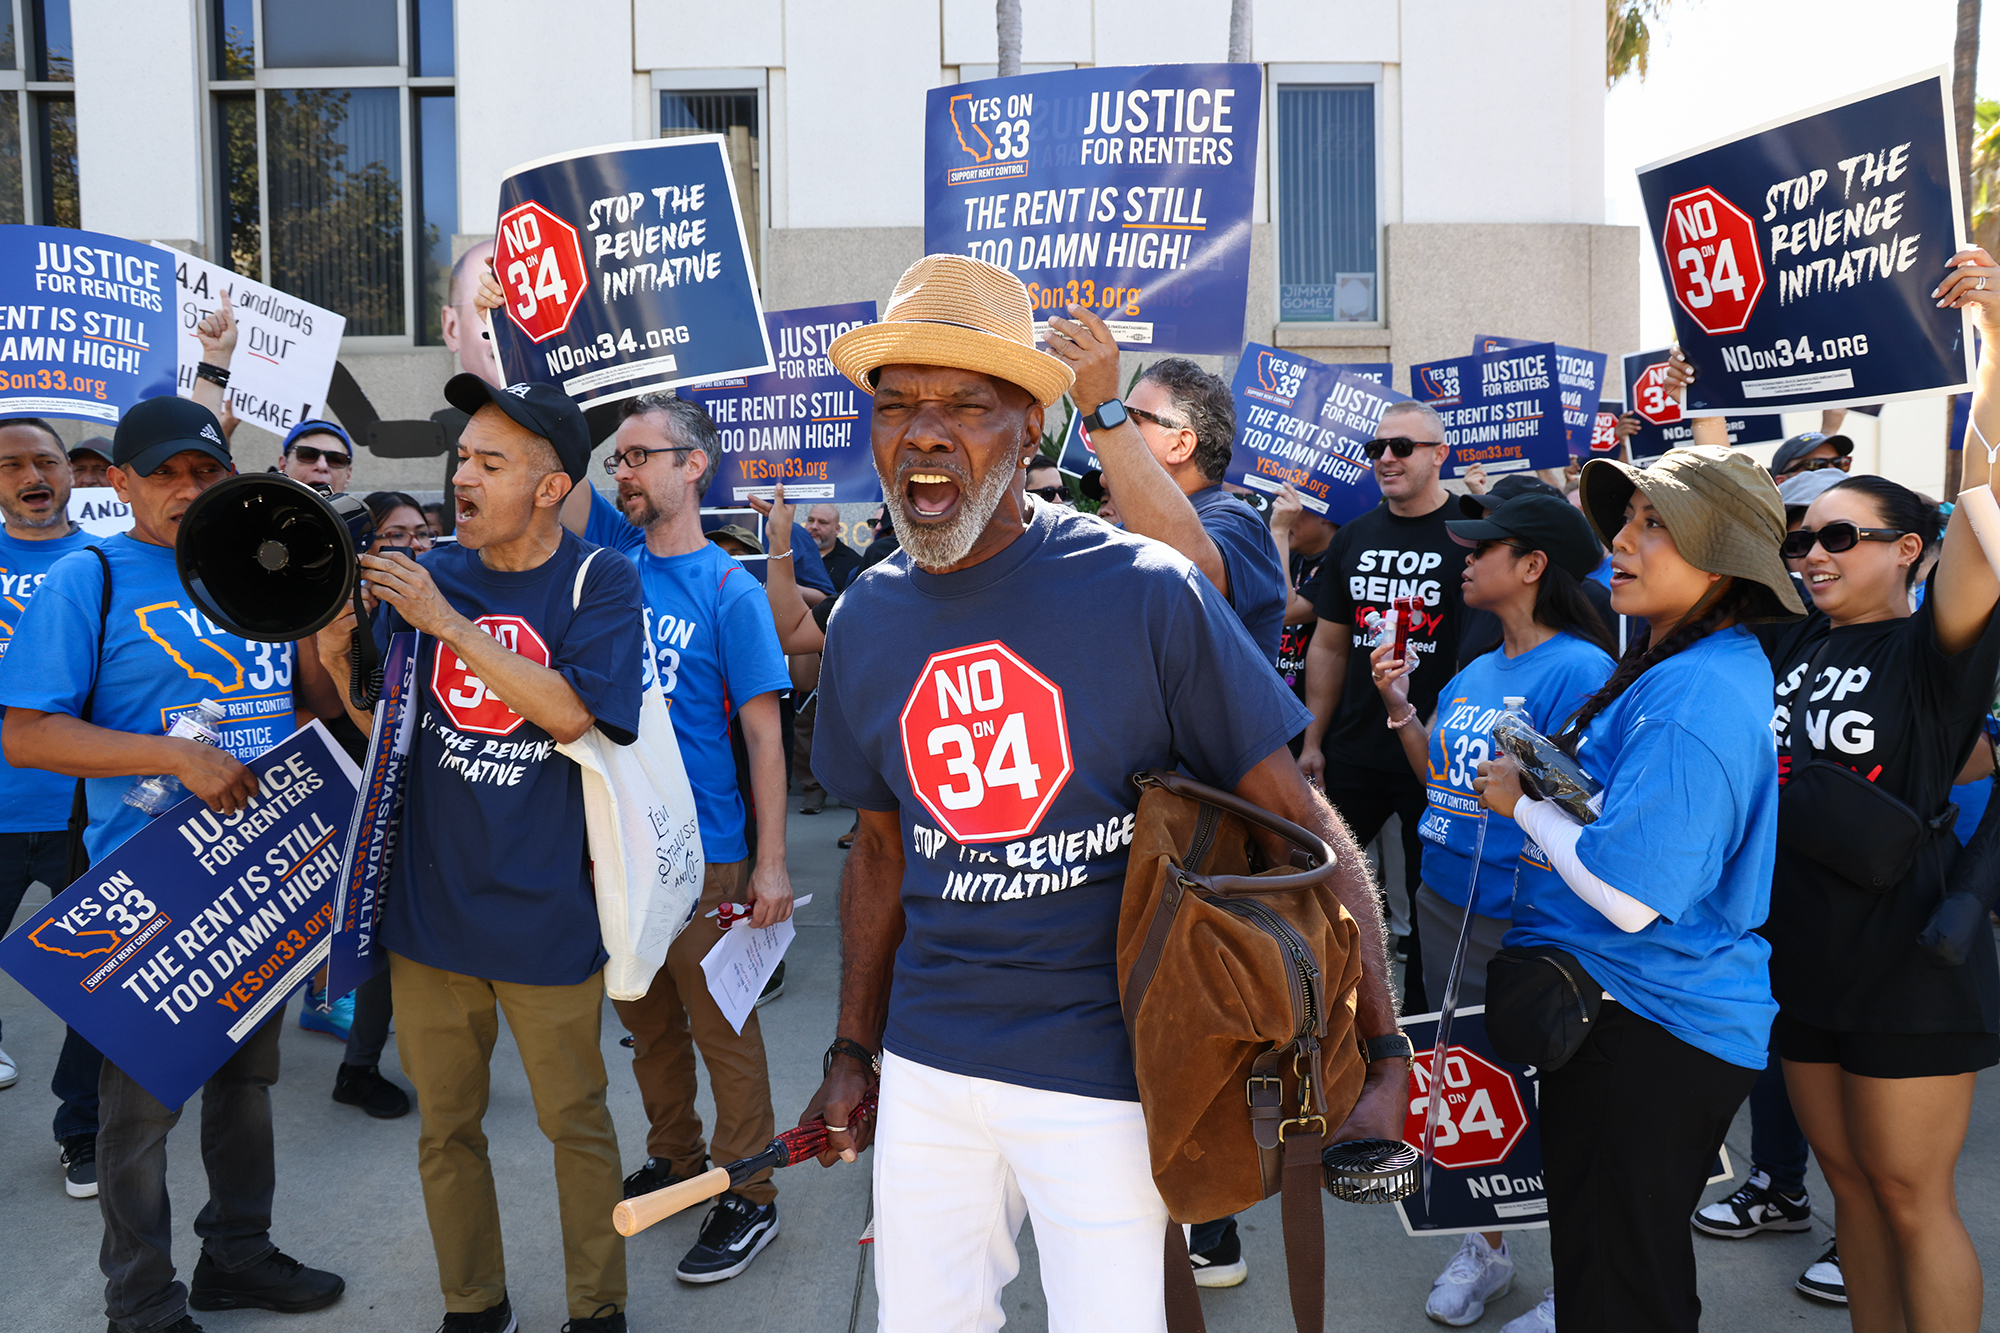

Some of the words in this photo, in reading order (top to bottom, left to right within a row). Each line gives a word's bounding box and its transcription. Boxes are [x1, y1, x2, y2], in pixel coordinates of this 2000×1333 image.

[969, 98, 1001, 123] YES
[1007, 94, 1033, 118] ON
[1084, 88, 1236, 135] JUSTICE
[994, 119, 1030, 160] 33
[1081, 138, 1124, 165] FOR
[1128, 136, 1234, 165] RENTERS
[951, 168, 977, 182] SUPPORT
[978, 166, 995, 179] RENT
[995, 164, 1024, 177] CONTROL
[1762, 168, 1828, 222] STOP
[1838, 142, 1911, 199] THE
[587, 192, 645, 232] STOP
[651, 183, 706, 219] THE
[964, 194, 1010, 231] THE
[1013, 187, 1085, 227] RENT
[1088, 187, 1119, 222] IS
[1123, 186, 1207, 224] STILL
[1674, 199, 1719, 243] NO
[502, 212, 542, 258] NO
[594, 219, 707, 268] REVENGE
[1771, 191, 1906, 265] REVENGE
[35, 242, 161, 292] JUSTICE
[526, 254, 539, 268] ON
[1017, 233, 1099, 271] DAMN
[1105, 232, 1192, 270] HIGH!
[1702, 244, 1715, 257] ON
[507, 246, 568, 320] 34
[603, 249, 721, 304] INITIATIVE
[1677, 238, 1746, 309] 34
[1779, 233, 1921, 306] INITIATIVE
[36, 272, 77, 296] FOR
[80, 278, 163, 313] RENTERS
[1022, 279, 1142, 316] Son33.org
[1282, 297, 1333, 309] GOMEZ
[1284, 286, 1331, 298] JIMMY
[0, 305, 46, 331] ENT
[51, 306, 77, 332] IS
[83, 310, 149, 347] STILL
[249, 326, 296, 360] OUT
[0, 336, 66, 363] AMN
[73, 339, 140, 375] HIGH!
[779, 359, 806, 380] FOR
[1268, 356, 1288, 374] YES
[1289, 363, 1307, 380] ON
[1428, 368, 1445, 382] YES
[1446, 366, 1459, 378] ON
[1481, 354, 1548, 384] JUSTICE
[0, 369, 108, 400] Son33.org
[506, 382, 531, 399] LA
[714, 378, 724, 387] RENT
[725, 377, 746, 387] CONTROL
[1275, 375, 1301, 399] 33
[1442, 378, 1460, 397] 33
[1482, 382, 1503, 398] FOR
[1504, 375, 1550, 394] RENTERS
[705, 400, 737, 424] THE
[741, 395, 787, 422] RENT
[790, 393, 807, 419] IS
[811, 390, 859, 418] STILL
[1320, 402, 1346, 424] FOR
[1326, 381, 1394, 422] JUSTIC
[1456, 406, 1489, 426] RENT
[1490, 405, 1504, 422] IS
[1506, 399, 1544, 420] STILL
[200, 431, 222, 445] adidas
[749, 425, 801, 452] DAMN
[805, 422, 852, 449] HIGH!
[1246, 404, 1278, 430] THE
[1274, 413, 1319, 442] RENT
[1315, 429, 1336, 449] IS
[1461, 424, 1500, 445] DAMN
[1502, 419, 1539, 440] HIGH!
[1590, 427, 1616, 446] 34
[1595, 415, 1613, 427] NO
[739, 457, 828, 481] YESon33.org
[1241, 427, 1272, 452] TOO
[1269, 434, 1321, 468] DAMN
[1317, 454, 1363, 486] HIGH!
[1455, 445, 1523, 463] YESon33.org
[1256, 456, 1331, 499] YESon33.org
[80, 500, 129, 521] AND
[1356, 549, 1443, 576] STOP
[1350, 576, 1442, 607] BEING
[657, 614, 696, 650] ON
[245, 639, 292, 690] 33
[229, 702, 255, 717] RENT
[256, 697, 292, 714] CONTROL
[934, 658, 1005, 719] NO
[972, 719, 995, 738] ON
[1443, 704, 1474, 731] YES
[218, 727, 273, 749] JUSTICE
[437, 726, 479, 752] THE
[926, 711, 1042, 811] 34
[1450, 734, 1489, 792] 33
[365, 728, 402, 882] DEMASIADA
[1448, 795, 1481, 813] CONTROL
[199, 835, 245, 876] FOR
[237, 772, 324, 844] RENTERS
[647, 805, 670, 842] LEVI
[913, 824, 948, 860] STOP
[1005, 811, 1135, 870] REVENGE
[655, 819, 697, 884] STRAUSS
[941, 865, 1089, 903] INITIATIVE
[54, 896, 102, 937] YES
[98, 870, 134, 903] ON
[106, 889, 157, 936] 33
[121, 945, 184, 1004] THE
[174, 886, 244, 961] RENT
[238, 865, 271, 902] IS
[265, 812, 335, 877] STILL
[154, 968, 214, 1025] TOO
[207, 899, 286, 980] DAMN
[278, 842, 343, 914] HIGH!
[357, 887, 375, 958] ALTA!
[86, 958, 119, 988] SUPPORT
[117, 940, 138, 963] RENT
[134, 917, 167, 947] CONTROL
[216, 901, 334, 1013] YESon33.org
[1413, 1056, 1471, 1093] NO
[1448, 1092, 1467, 1105] ON
[1410, 1088, 1505, 1148] 34
